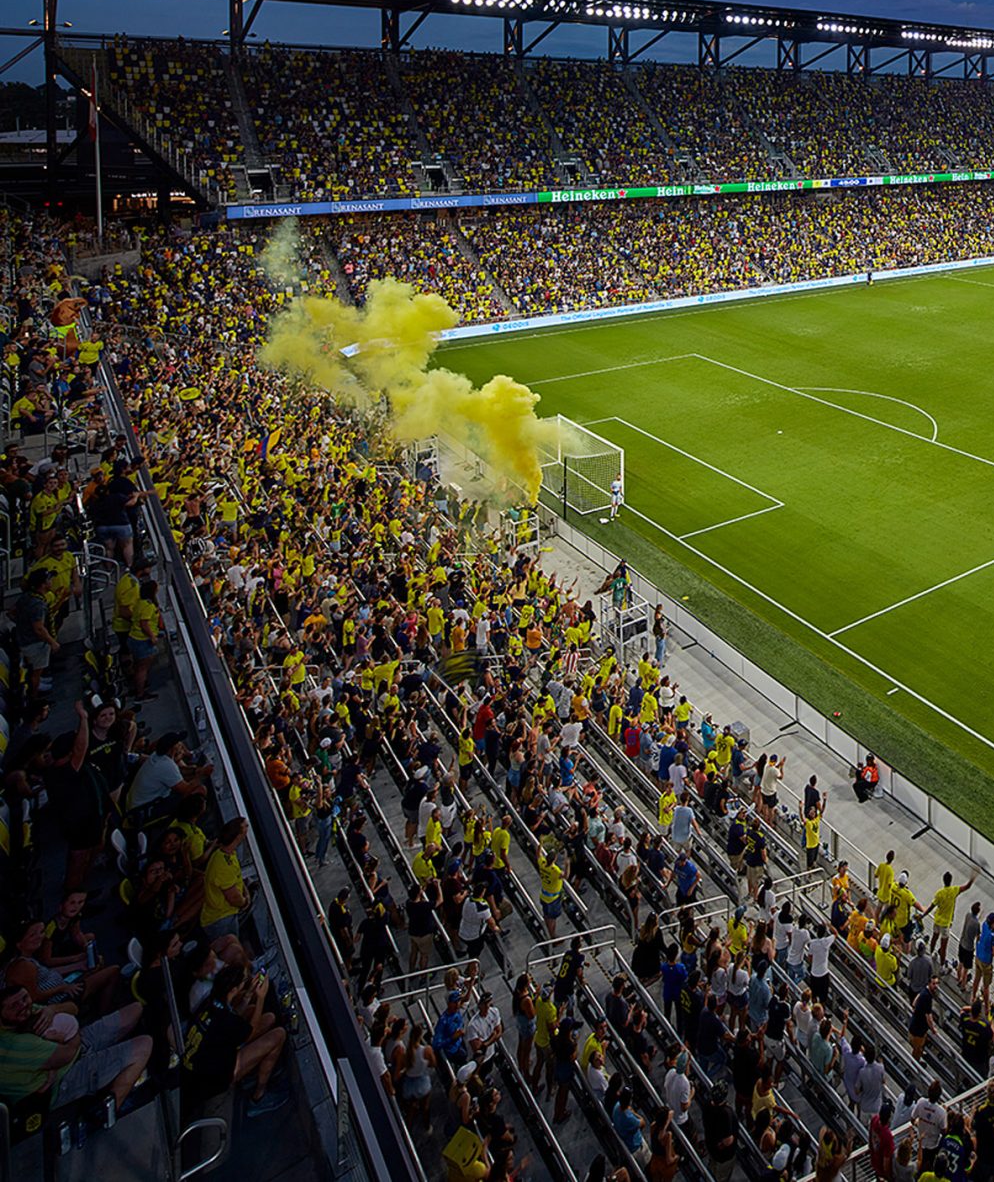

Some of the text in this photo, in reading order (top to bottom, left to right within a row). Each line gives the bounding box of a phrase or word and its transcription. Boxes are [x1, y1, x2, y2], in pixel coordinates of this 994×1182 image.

[890, 174, 927, 184] Heineken
[747, 182, 795, 192] Heineken
[492, 196, 527, 204] RENASANT
[551, 190, 615, 202] Heineken
[341, 203, 384, 212] RENASANT
[420, 200, 459, 208] RENASANT
[254, 207, 302, 217] RENASANT
[559, 961, 570, 978] 8
